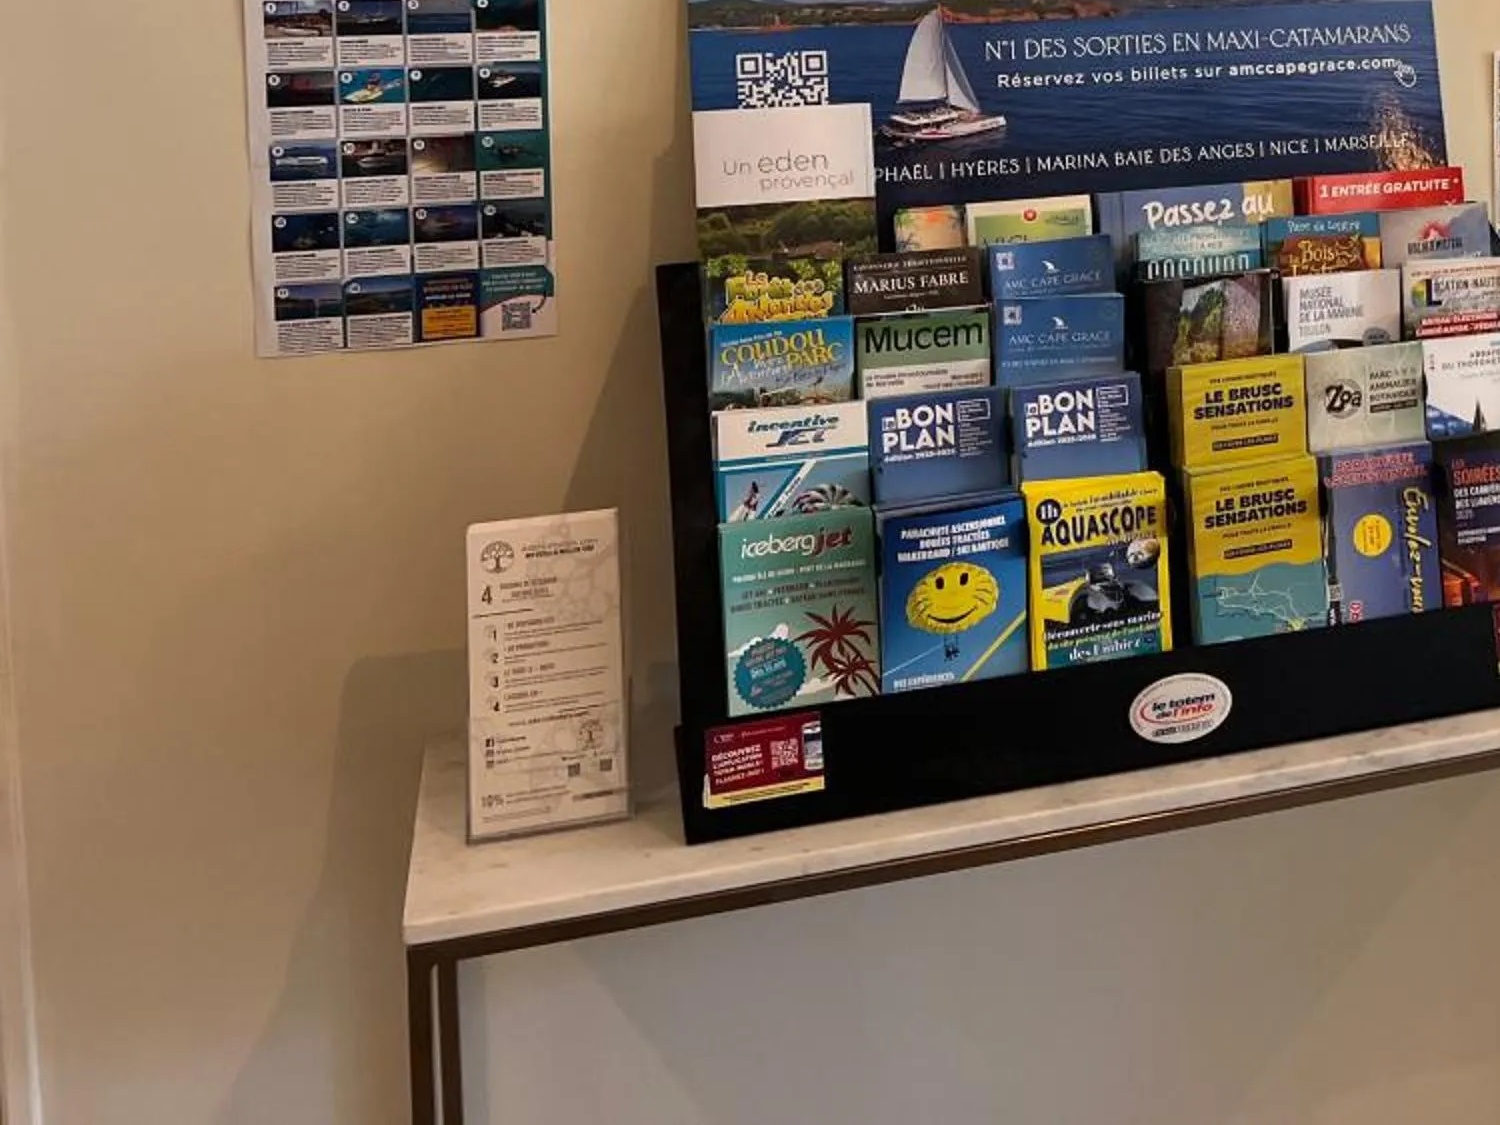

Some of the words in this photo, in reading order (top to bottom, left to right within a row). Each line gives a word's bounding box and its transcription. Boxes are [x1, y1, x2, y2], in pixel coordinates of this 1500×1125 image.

[1025, 38, 1067, 60] DES
[1072, 33, 1167, 58] SORTIES
[1173, 31, 1200, 52] EN
[1206, 23, 1412, 52] MAXI-CATAMARANS
[997, 69, 1084, 89] Réservez
[1092, 70, 1124, 84] vos
[1130, 65, 1188, 82] billets
[1195, 64, 1223, 79] sur
[1229, 56, 1396, 79] amccapegrace.com
[723, 160, 751, 176] Un
[758, 150, 829, 174] eden
[1037, 152, 1110, 172] MARINA
[1115, 149, 1153, 167] BAIE
[1160, 147, 1191, 164] DES
[1198, 142, 1255, 161] ANGES
[1270, 138, 1308, 156] NICE
[1324, 132, 1409, 153] MARSEILLE
[760, 171, 855, 192] provençal
[1320, 185, 1328, 198] 1
[1331, 183, 1381, 198] ENTRÉE
[1383, 178, 1450, 194] GRATUITE
[1143, 197, 1235, 230] Passez
[1241, 192, 1275, 222] au
[853, 276, 915, 294] MARIUS
[920, 271, 969, 288] FABRE
[865, 322, 983, 353] Mucem
[1037, 388, 1094, 415] BON
[1205, 390, 1224, 404] LE
[1229, 383, 1282, 401] BRUSC
[896, 403, 954, 430] BON
[1193, 395, 1294, 420] SENSATIONS
[1025, 410, 1096, 438] PLAN
[883, 424, 956, 454] PLAN
[1215, 497, 1235, 513] LE
[1239, 488, 1295, 508] BRUSC
[1041, 506, 1156, 547] AQUASCOPE
[1204, 500, 1308, 529] SENSATIONS
[1169, 693, 1215, 708] totem
